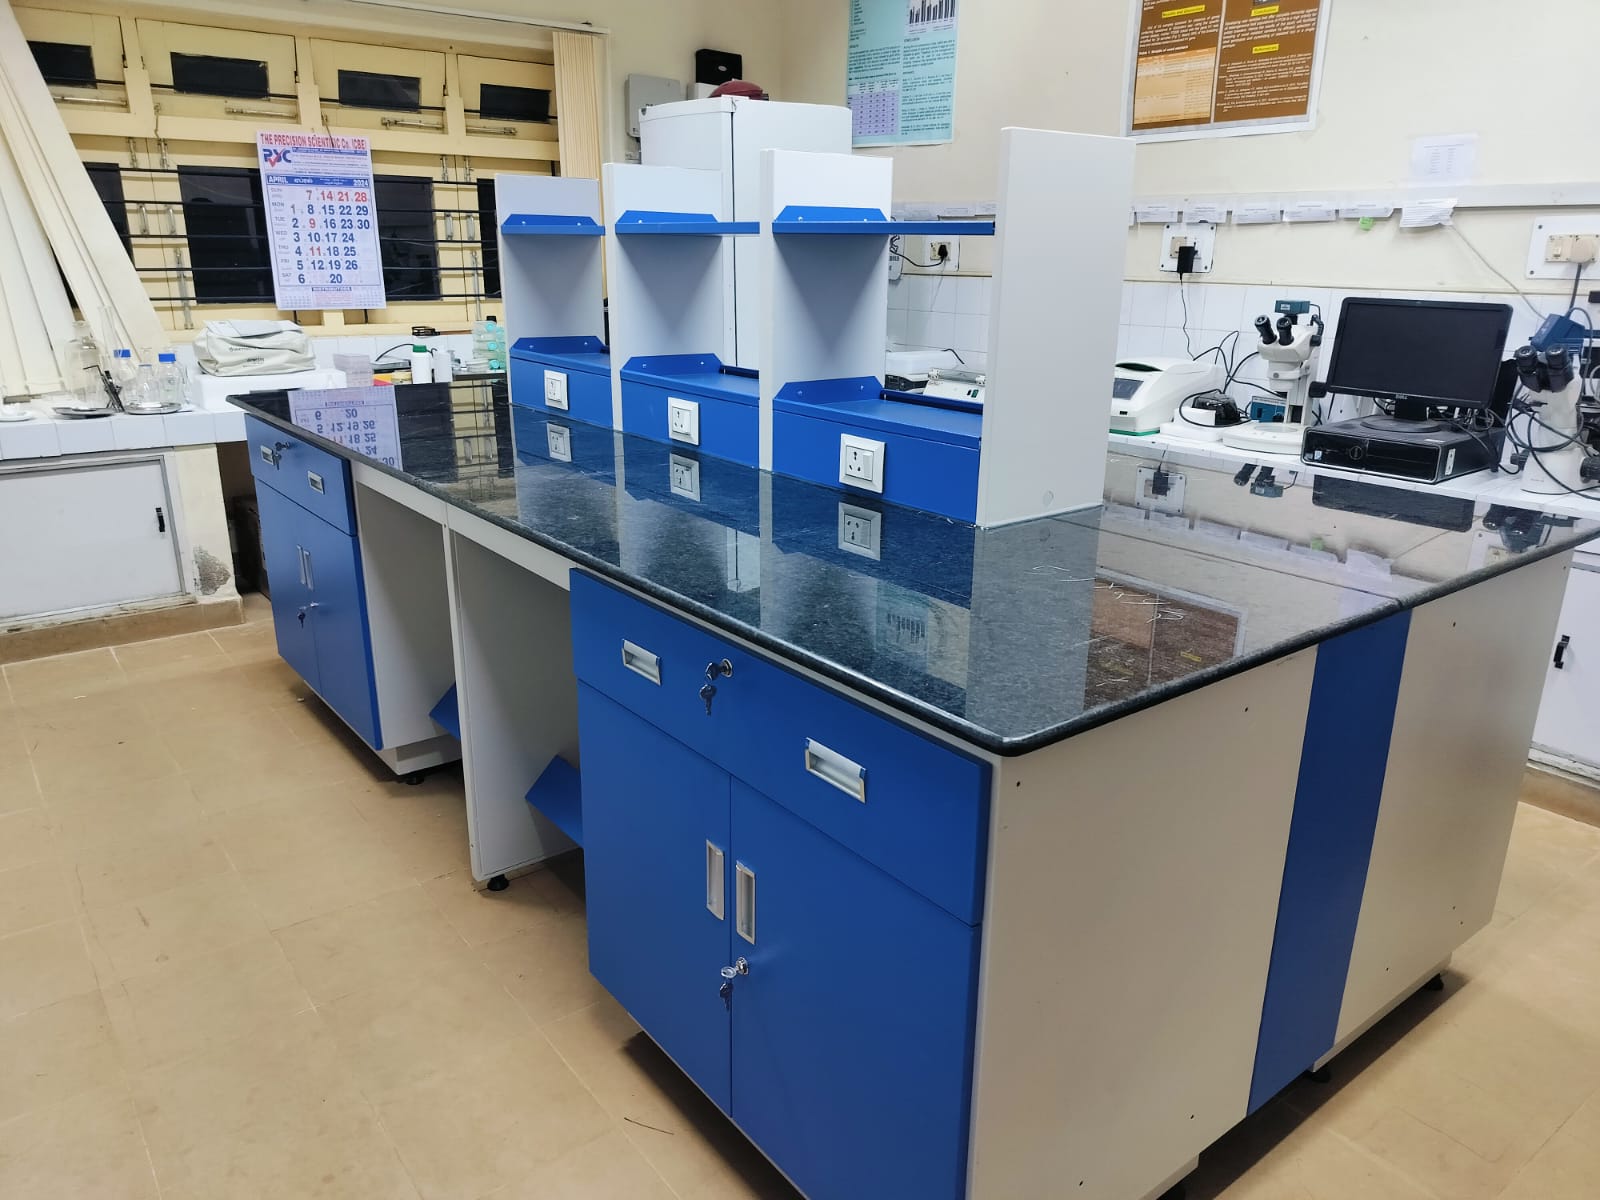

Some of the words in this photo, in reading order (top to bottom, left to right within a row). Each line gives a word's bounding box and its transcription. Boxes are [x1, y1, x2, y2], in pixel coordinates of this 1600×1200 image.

[260, 133, 273, 145] THE
[274, 134, 306, 147] PRECISION
[268, 175, 289, 185] APRIL
[305, 189, 313, 201] 7
[320, 190, 334, 202] 14
[337, 191, 350, 202] 21
[354, 191, 368, 202] 28
[290, 203, 297, 215] 1
[307, 203, 315, 215] 8
[321, 204, 335, 215] 15
[338, 204, 353, 216] 22
[355, 205, 369, 216] 29
[291, 217, 300, 229] 2
[308, 217, 317, 229] 9
[323, 218, 337, 229] 16
[340, 218, 354, 230] 23
[356, 218, 370, 230] 30
[293, 231, 301, 243] 3
[307, 231, 321, 243] 10
[325, 231, 338, 243] 17
[341, 232, 355, 243] 24
[294, 245, 303, 257] 4
[309, 245, 322, 257] 11
[326, 245, 340, 257] 18
[343, 246, 357, 257] 25
[296, 259, 304, 271] 5
[310, 259, 325, 271] 12
[328, 259, 342, 271] 19
[344, 259, 359, 271] 26
[297, 273, 306, 285] 6
[329, 273, 343, 284] 20
